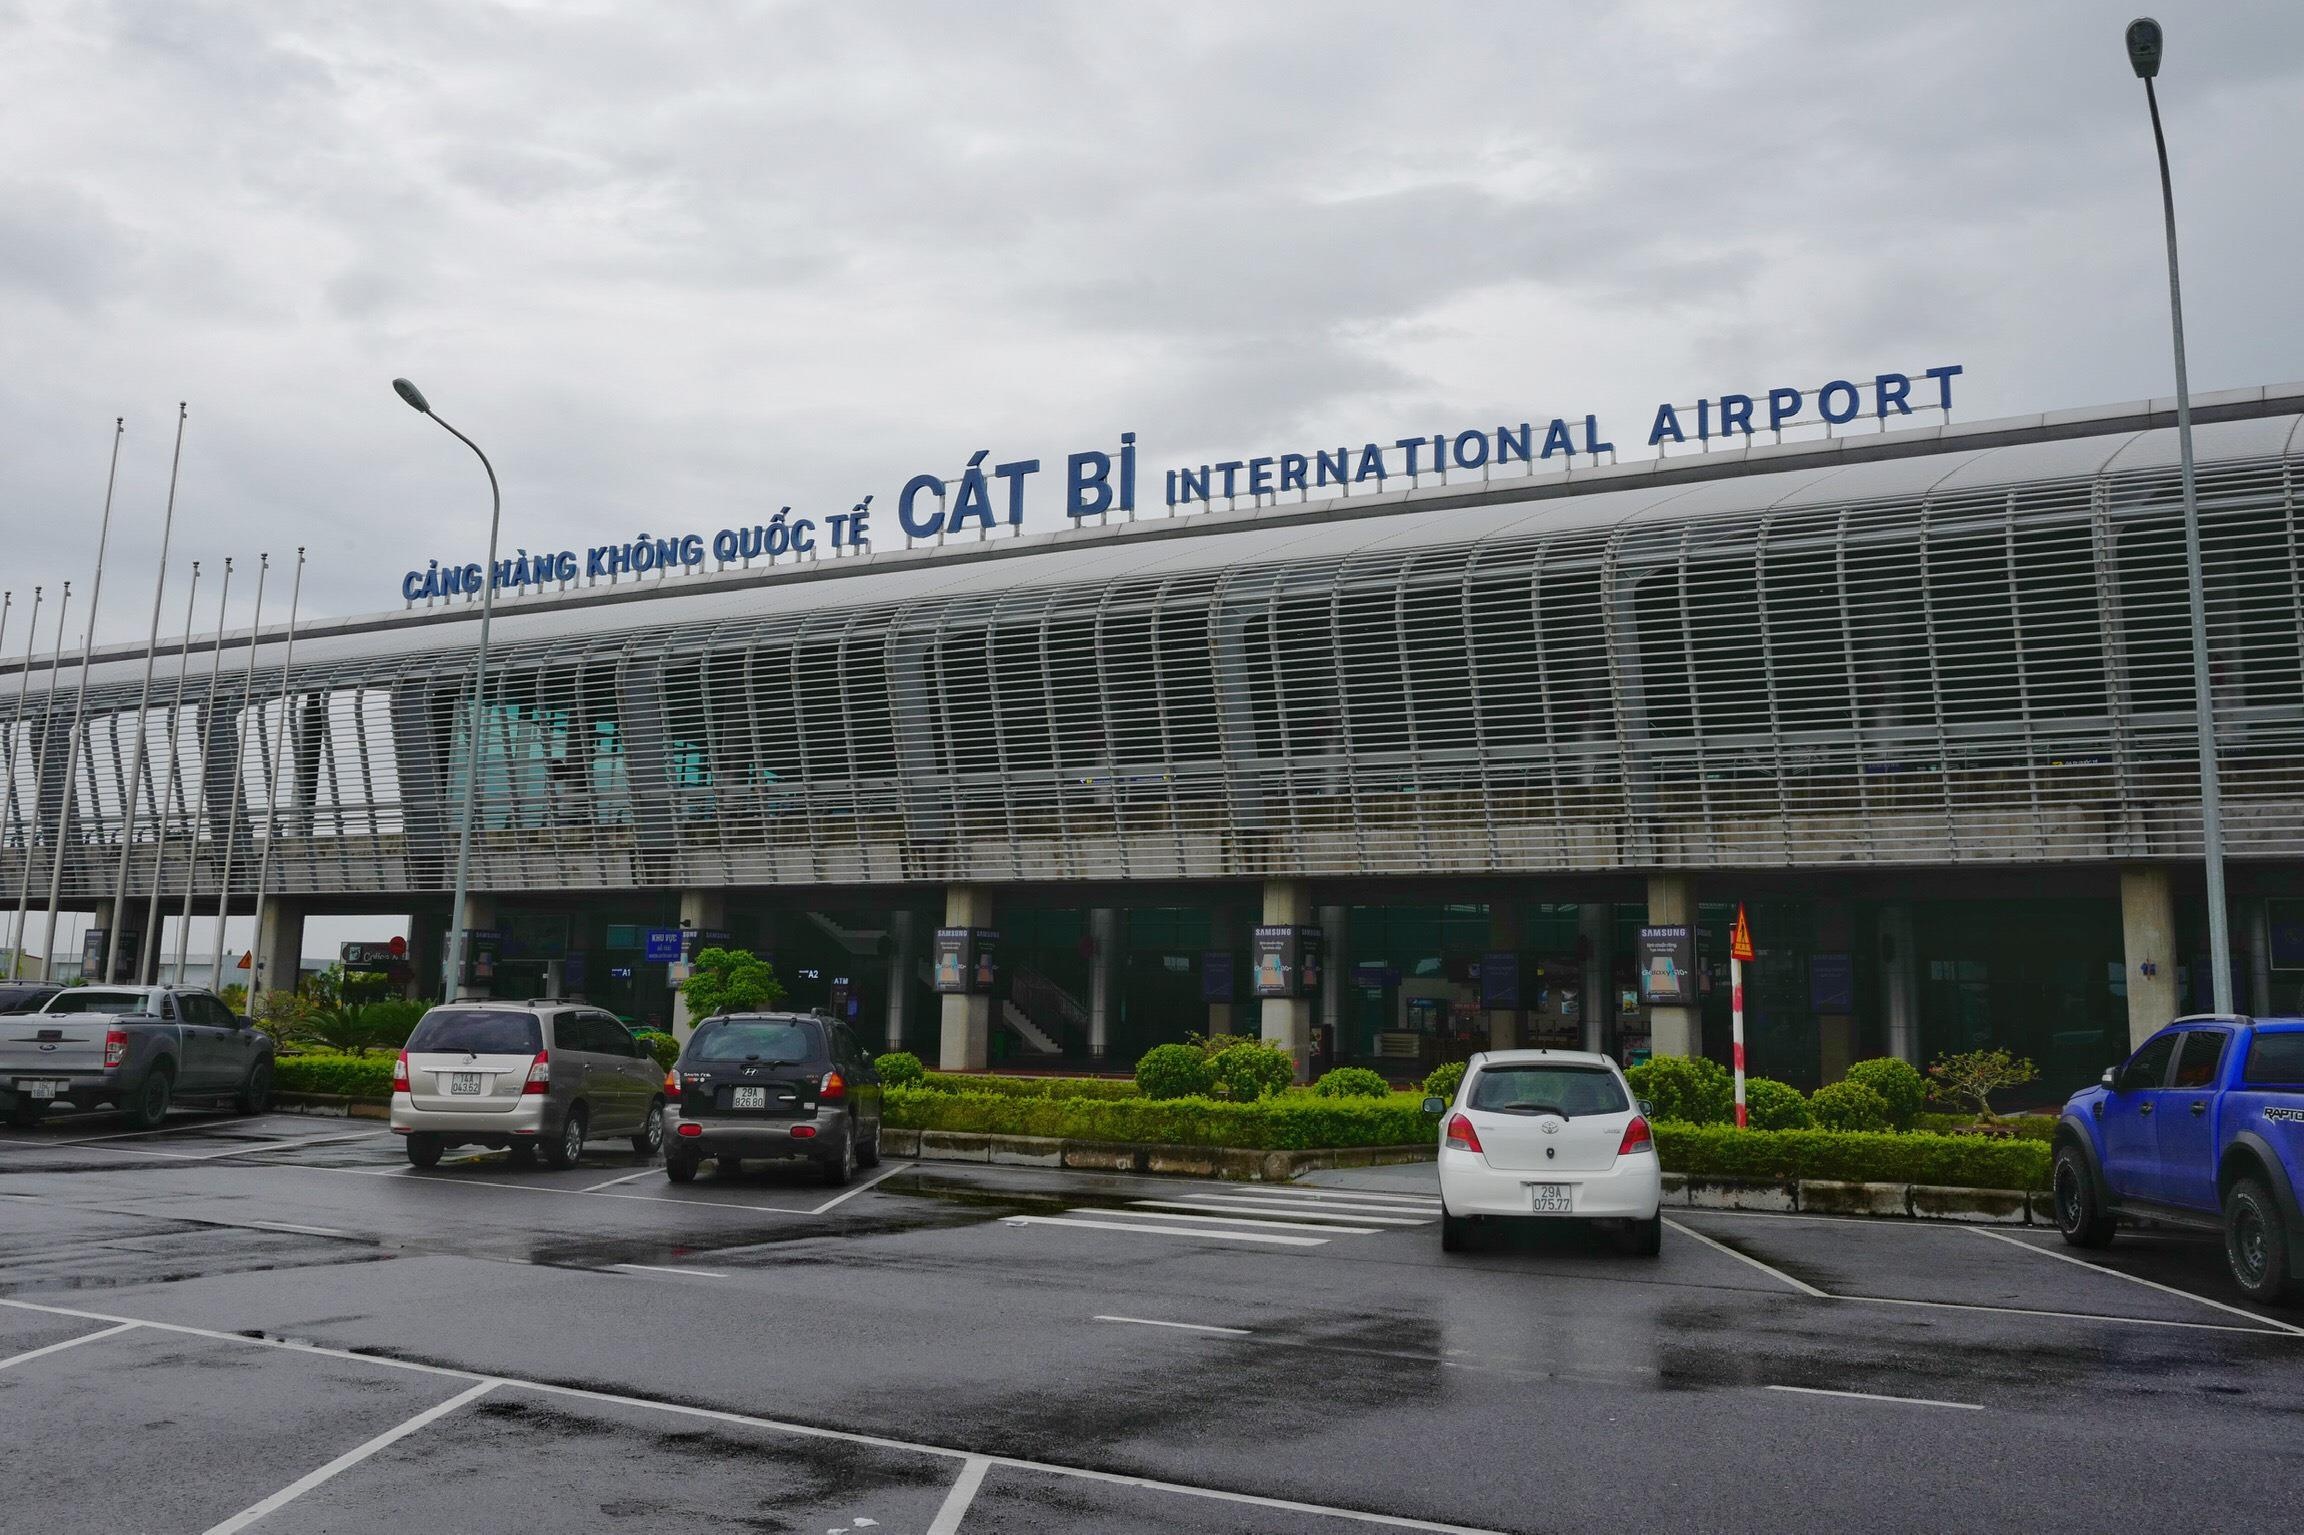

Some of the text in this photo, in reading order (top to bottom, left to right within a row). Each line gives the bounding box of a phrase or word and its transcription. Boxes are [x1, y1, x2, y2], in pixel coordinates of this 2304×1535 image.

[402, 559, 482, 600] CẢNG
[492, 549, 577, 589] HÀNG
[587, 533, 704, 577] KHÔNG
[713, 506, 815, 562] QUỐC
[825, 495, 873, 547] TẾ
[899, 450, 1041, 538] CÁT
[1166, 414, 1614, 506] INTERNATIONAL
[1648, 365, 1963, 446] AIRPORT
[1255, 928, 1292, 937] SAMSUNG
[1641, 928, 1686, 938] SAMSUNG
[807, 969, 819, 979] A2
[833, 977, 849, 985] ATM
[741, 1087, 758, 1098] 29A
[1541, 1186, 1562, 1198] 29A
